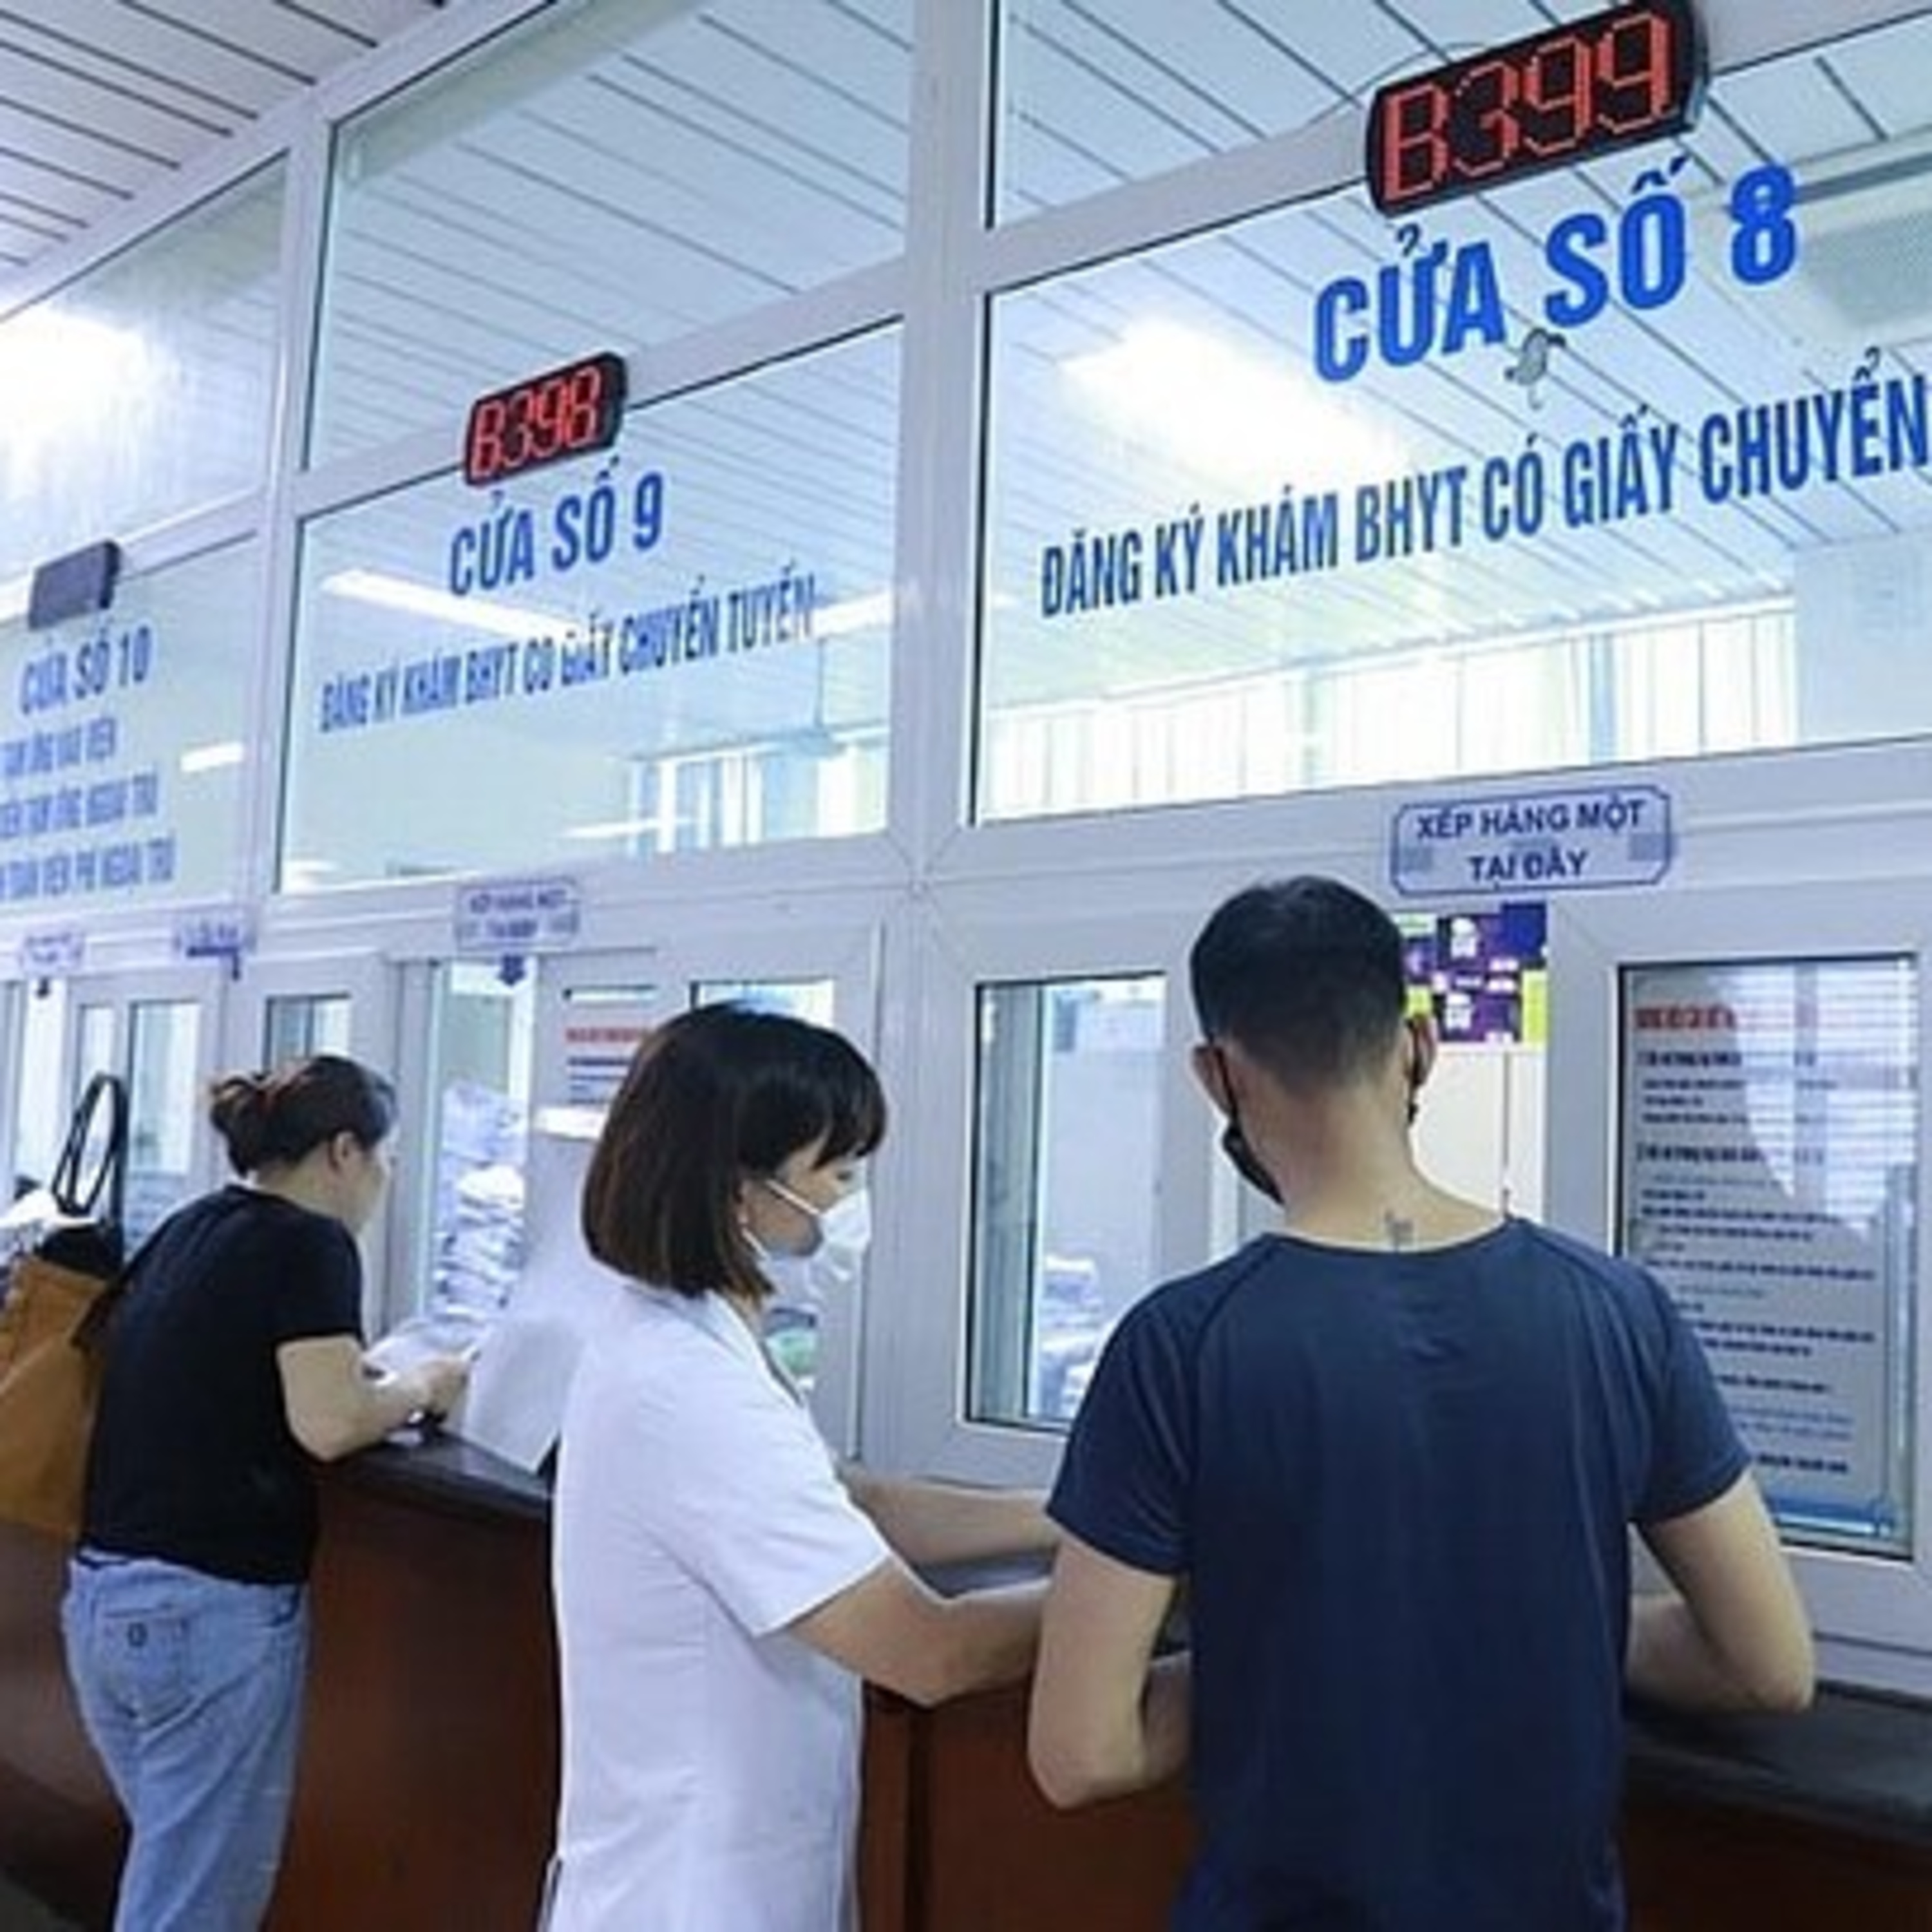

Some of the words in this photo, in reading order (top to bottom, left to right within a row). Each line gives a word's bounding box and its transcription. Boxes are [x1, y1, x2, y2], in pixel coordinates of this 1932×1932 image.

[1382, 10, 1673, 202] B399
[1314, 222, 1506, 383] CỬA
[1546, 155, 1686, 328] SỐ
[1730, 164, 1797, 286] 8
[450, 489, 534, 596] CỬA
[551, 454, 620, 573] SỐ
[633, 471, 663, 550] 9
[1041, 527, 1142, 618] ĐĂNG
[1155, 501, 1204, 599] KÝ
[1218, 483, 1338, 587] KHÁM
[1355, 465, 1467, 563] BHYT
[1482, 430, 1544, 542] CÓ
[1564, 402, 1680, 528] GIẤY
[1700, 345, 1928, 505] CHUYỂN
